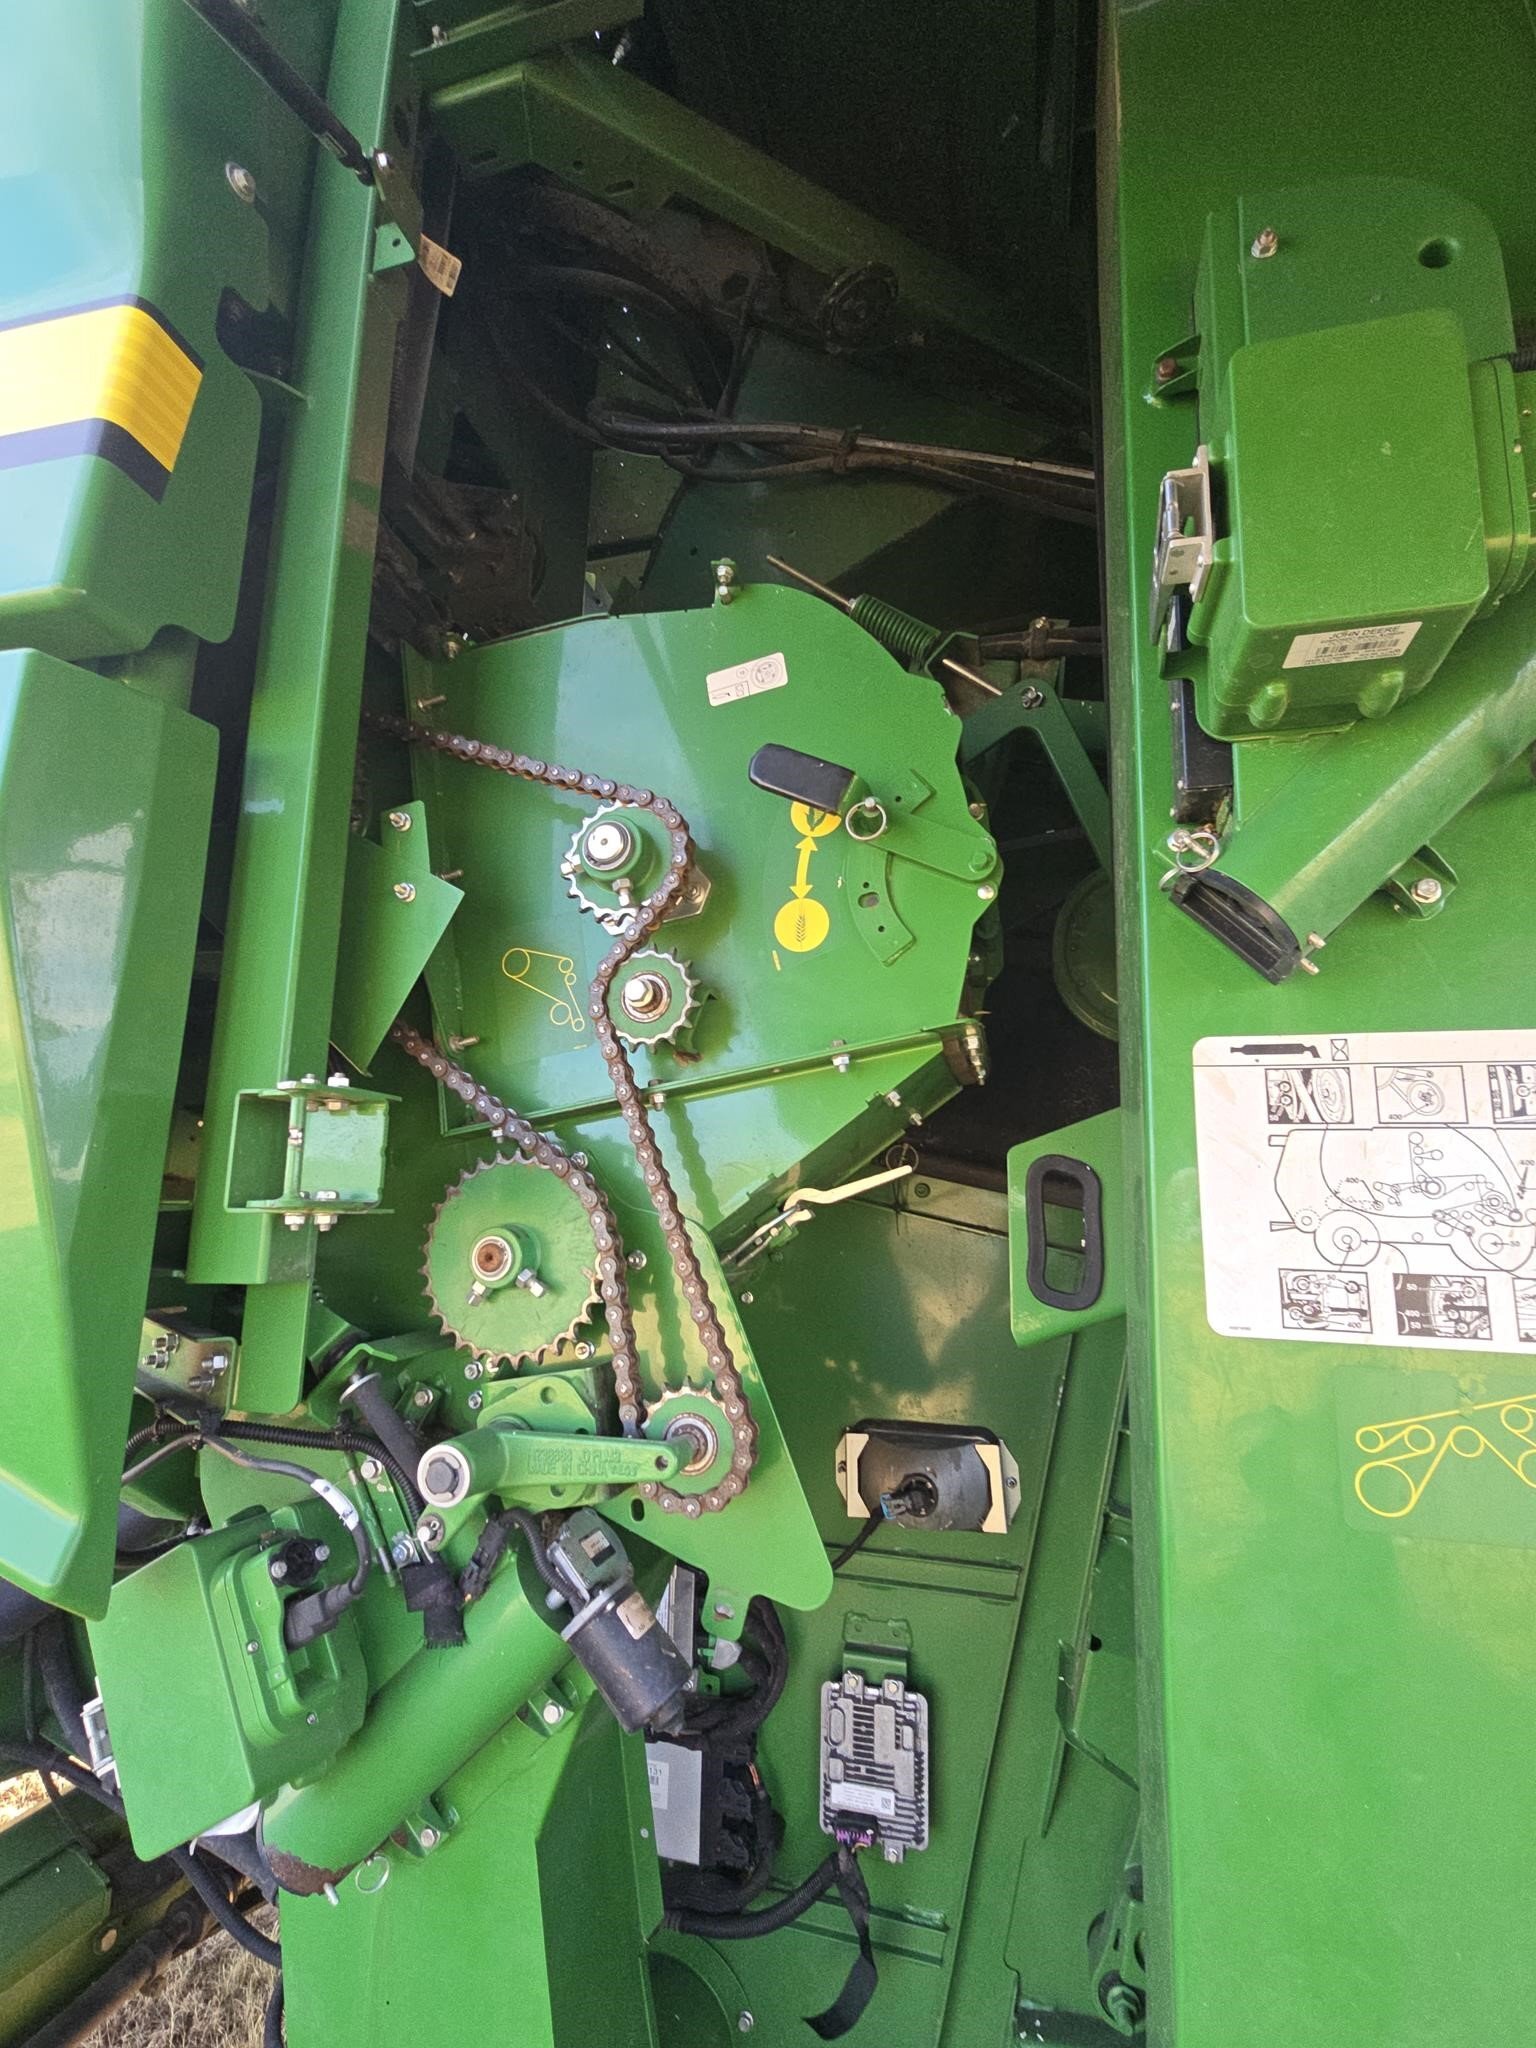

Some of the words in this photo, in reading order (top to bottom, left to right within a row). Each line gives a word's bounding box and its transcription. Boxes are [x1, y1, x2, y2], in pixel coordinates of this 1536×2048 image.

[1329, 630, 1359, 639] JOHN
[1362, 626, 1401, 636] DEERE
[1406, 1283, 1417, 1291] 50
[1347, 1321, 1361, 1329] 400
[1410, 1321, 1421, 1329] 50
